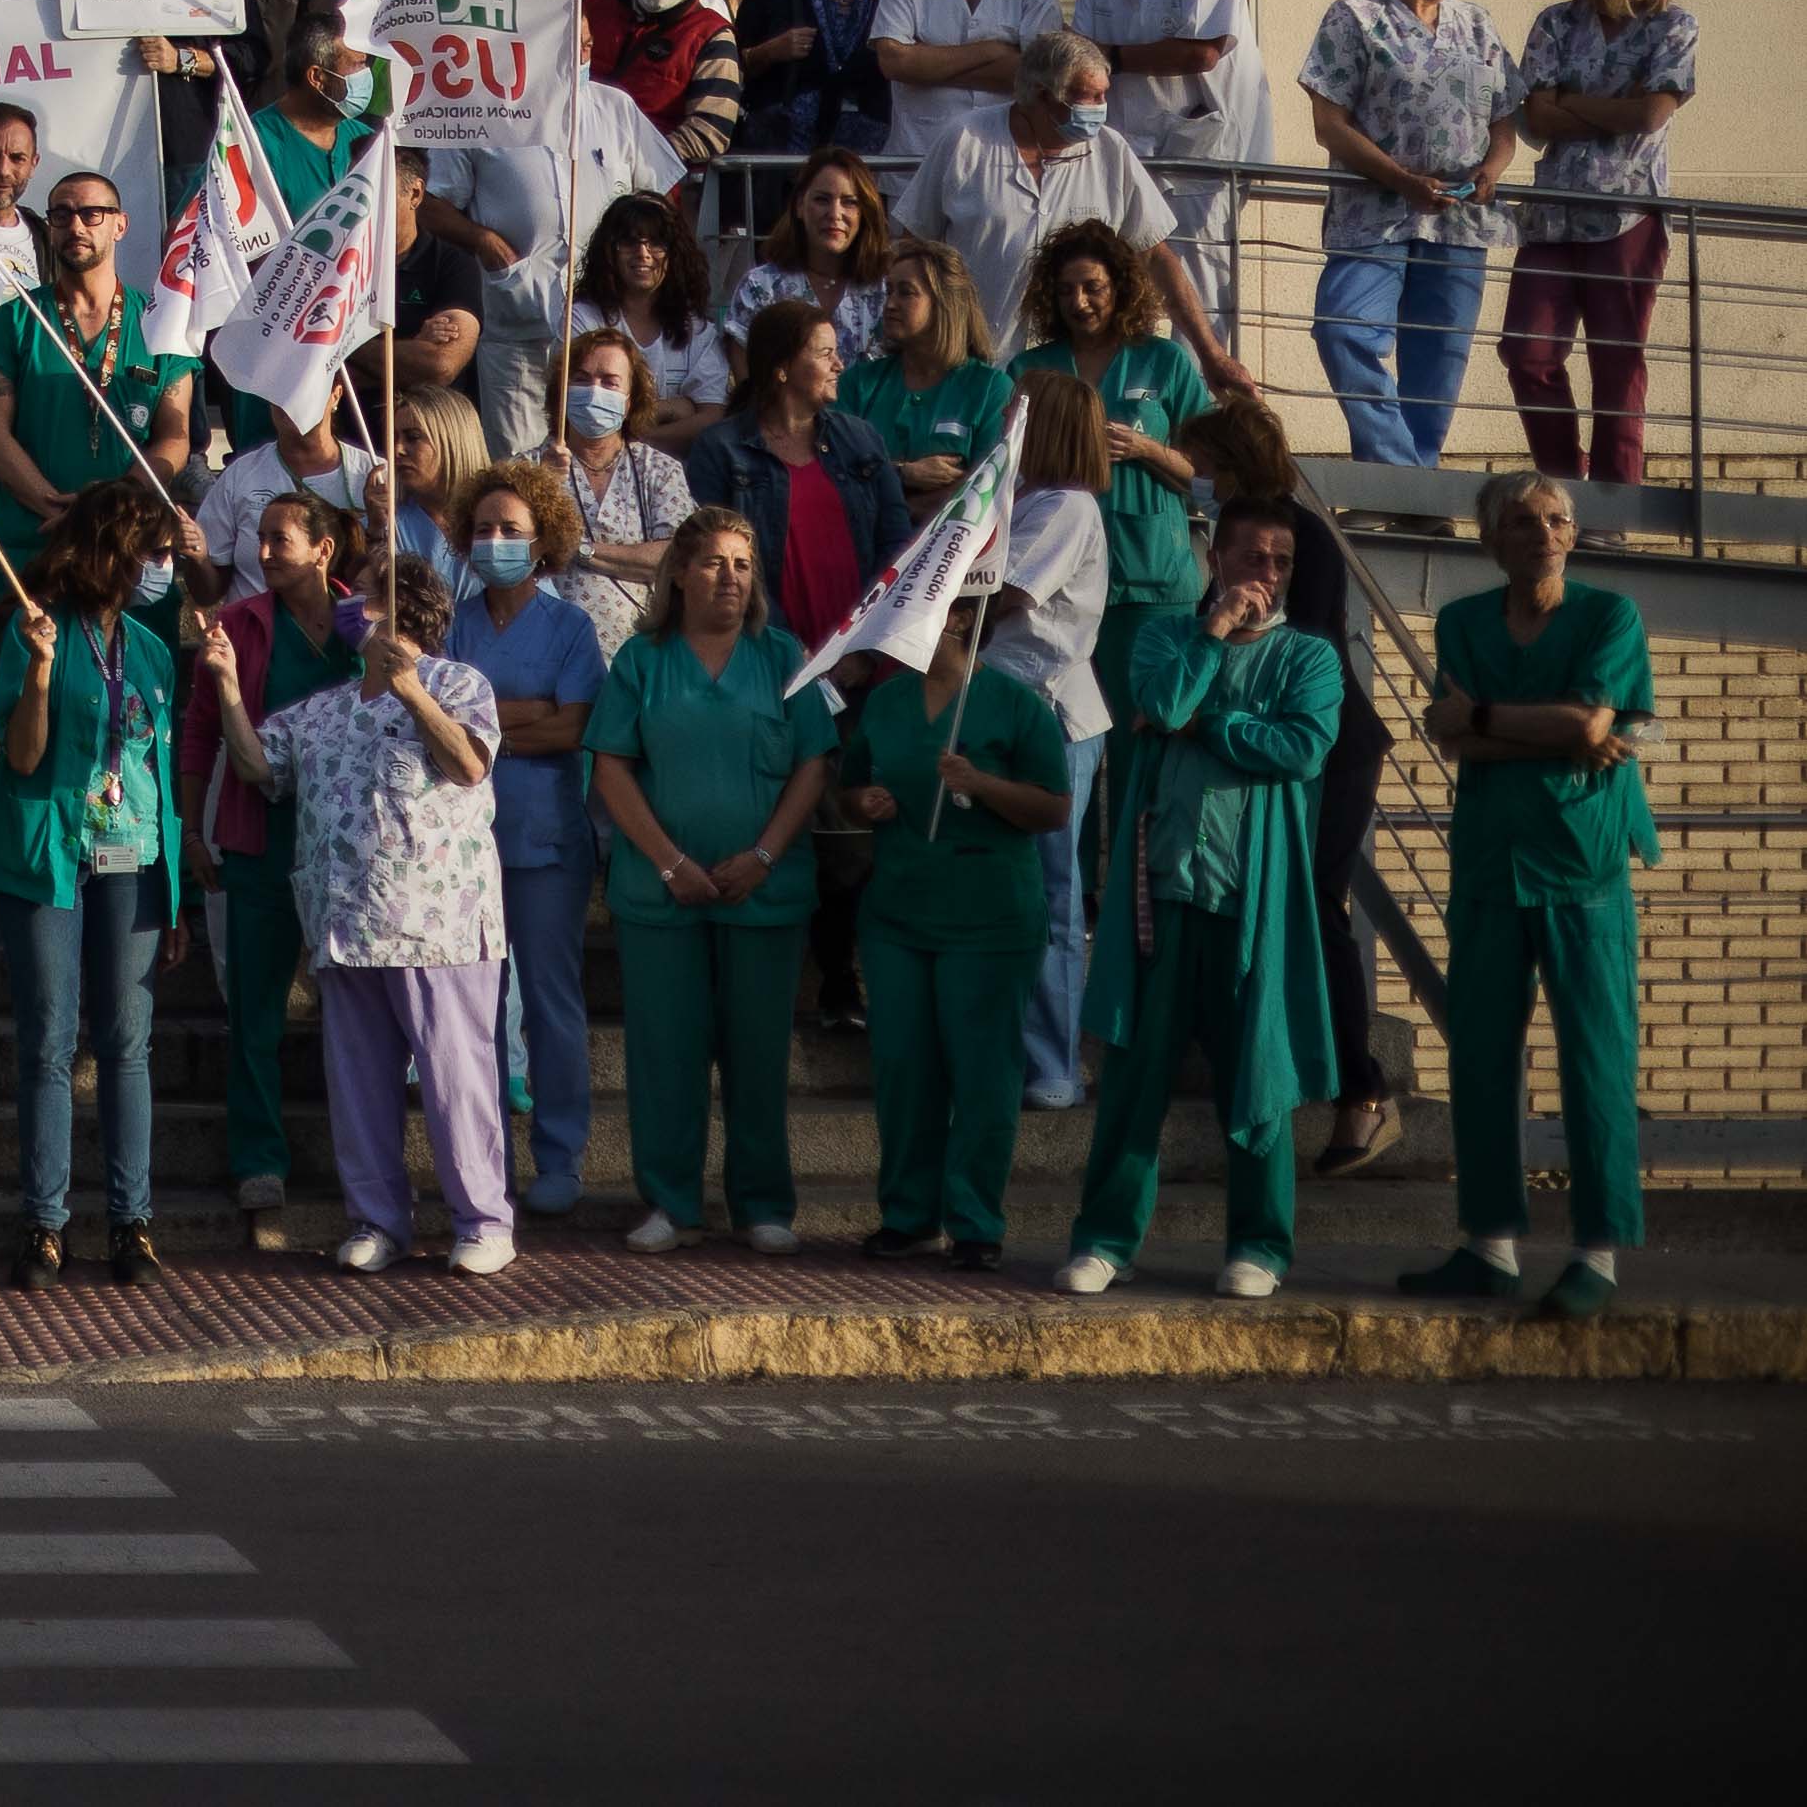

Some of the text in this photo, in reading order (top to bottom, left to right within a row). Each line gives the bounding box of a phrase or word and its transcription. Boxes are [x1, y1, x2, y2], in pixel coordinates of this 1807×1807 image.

[924, 526, 971, 602] Federación
[243, 1402, 1651, 1427] PROHIBIDO FUMAR
[233, 1427, 360, 1442] En
[388, 1427, 608, 1442] todo
[643, 1427, 723, 1441] el
[763, 1426, 1139, 1441] Recinto
